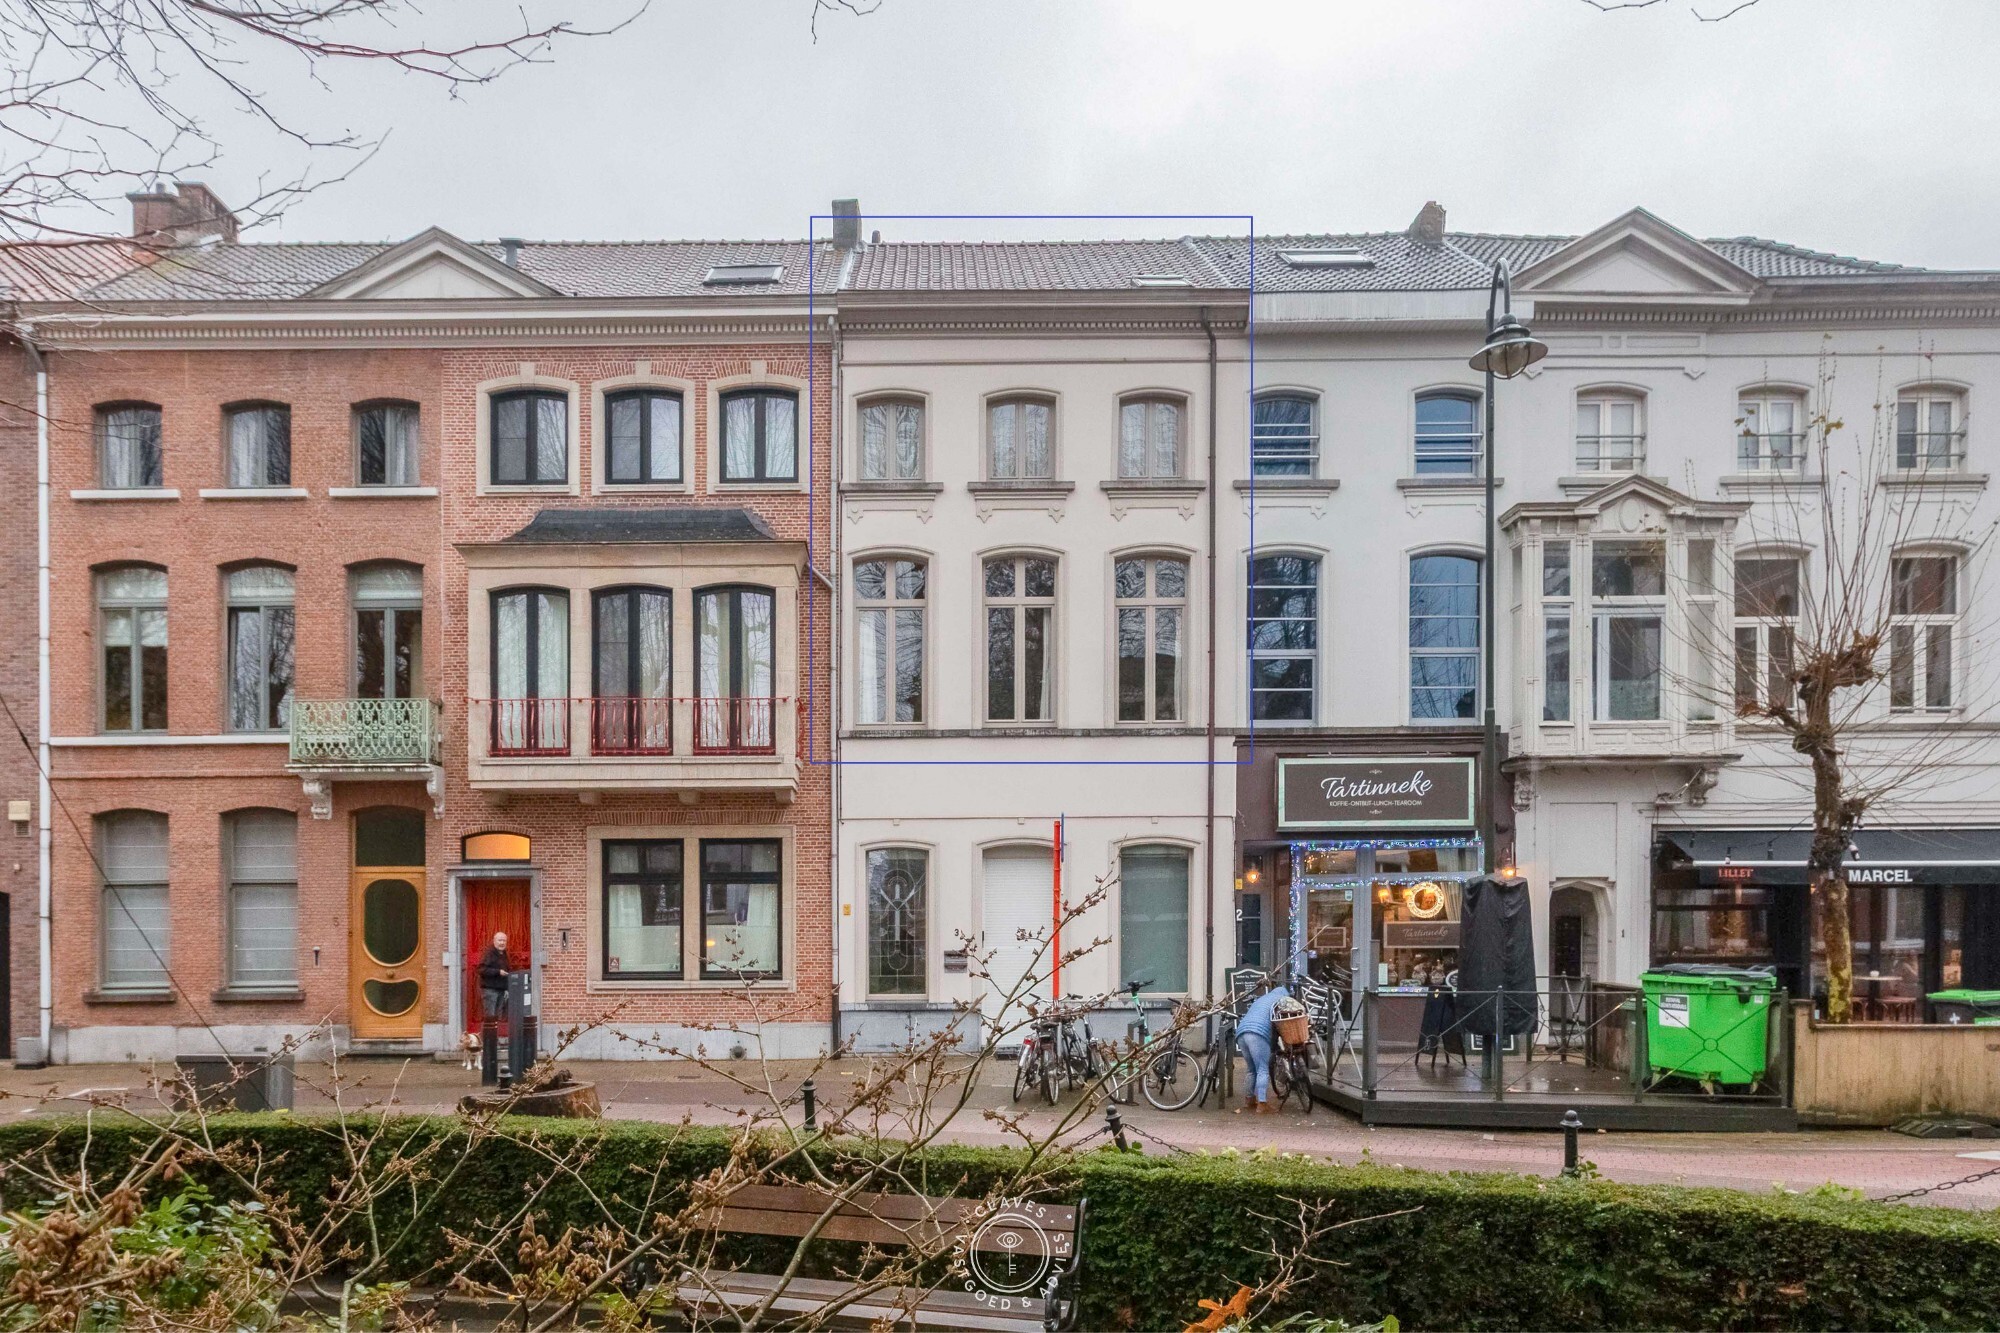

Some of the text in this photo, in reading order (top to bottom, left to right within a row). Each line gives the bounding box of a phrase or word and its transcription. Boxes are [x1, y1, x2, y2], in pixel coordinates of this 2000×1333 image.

[1320, 769, 1433, 799] Tartinneke
[1718, 868, 1754, 878] LILLET
[1848, 869, 1914, 882] MARCEL
[1236, 908, 1243, 922] 2
[954, 928, 960, 937] 3
